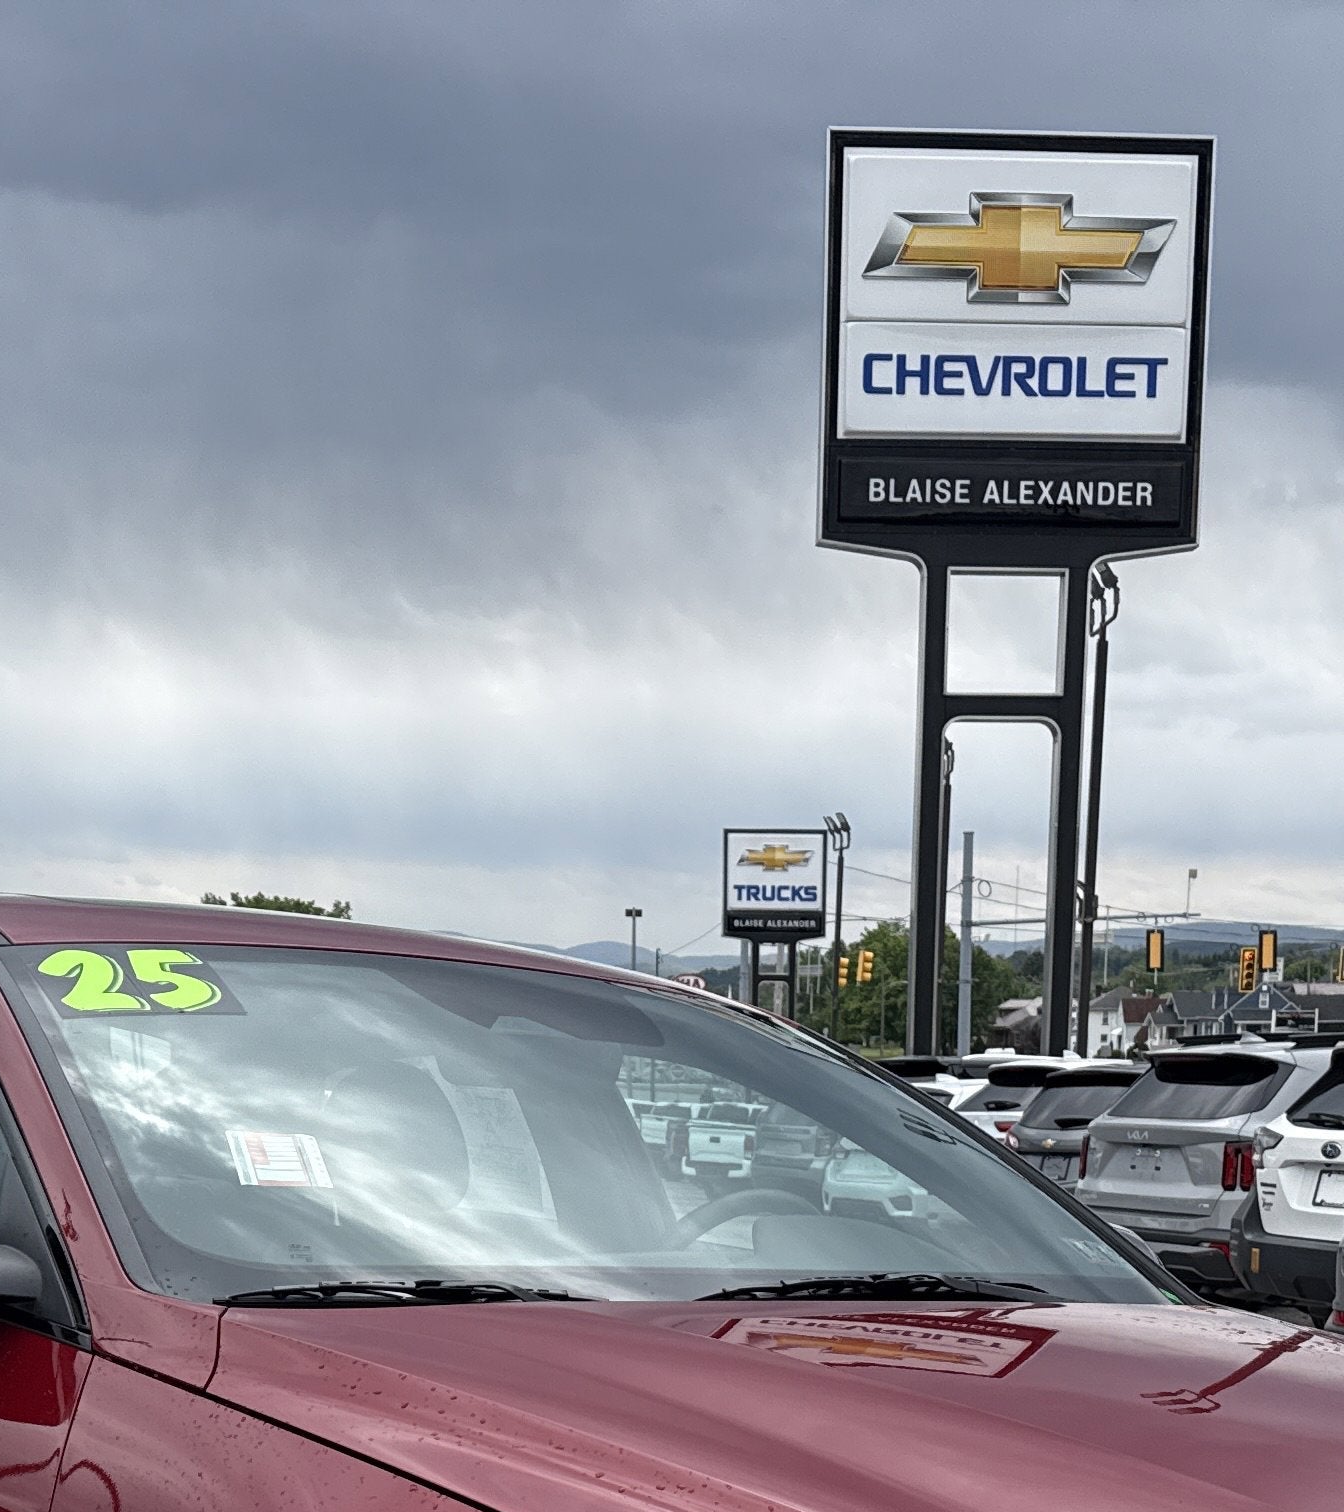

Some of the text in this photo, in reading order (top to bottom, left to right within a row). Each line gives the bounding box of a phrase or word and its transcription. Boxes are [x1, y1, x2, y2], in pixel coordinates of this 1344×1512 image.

[862, 352, 1169, 399] CHEVROLET
[868, 478, 1154, 507] BLAISE ALEXANDER
[733, 884, 818, 902] TRUCKS
[733, 919, 816, 928] BLAISE ALEXANDER
[37, 949, 222, 1012] 25
